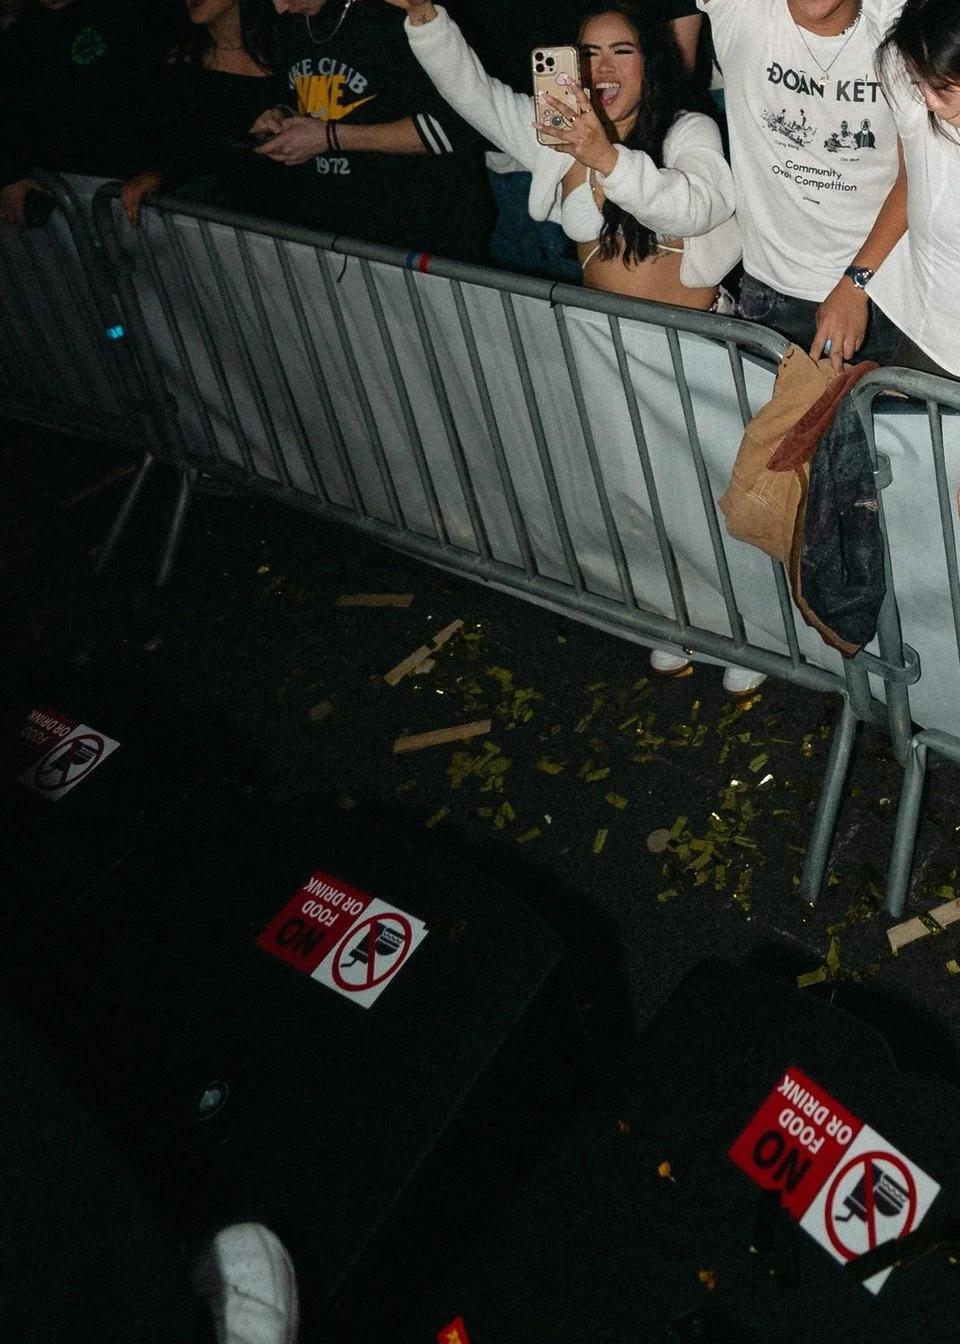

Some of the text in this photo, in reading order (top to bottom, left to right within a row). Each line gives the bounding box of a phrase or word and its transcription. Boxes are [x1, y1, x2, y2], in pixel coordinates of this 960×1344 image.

[318, 57, 368, 94] CLUB
[836, 74, 881, 103] KẾT
[315, 156, 351, 175] 1972
[771, 165, 857, 192] Over Competition
[785, 160, 842, 180] Community
[26, 709, 71, 737] OR DRINK
[302, 876, 364, 916] OR DRINK
[301, 900, 340, 928] FOOD
[276, 919, 325, 957] NO
[776, 1074, 853, 1145] OR DRINK
[778, 1108, 826, 1155] FOOD
[753, 1130, 812, 1193] NO
